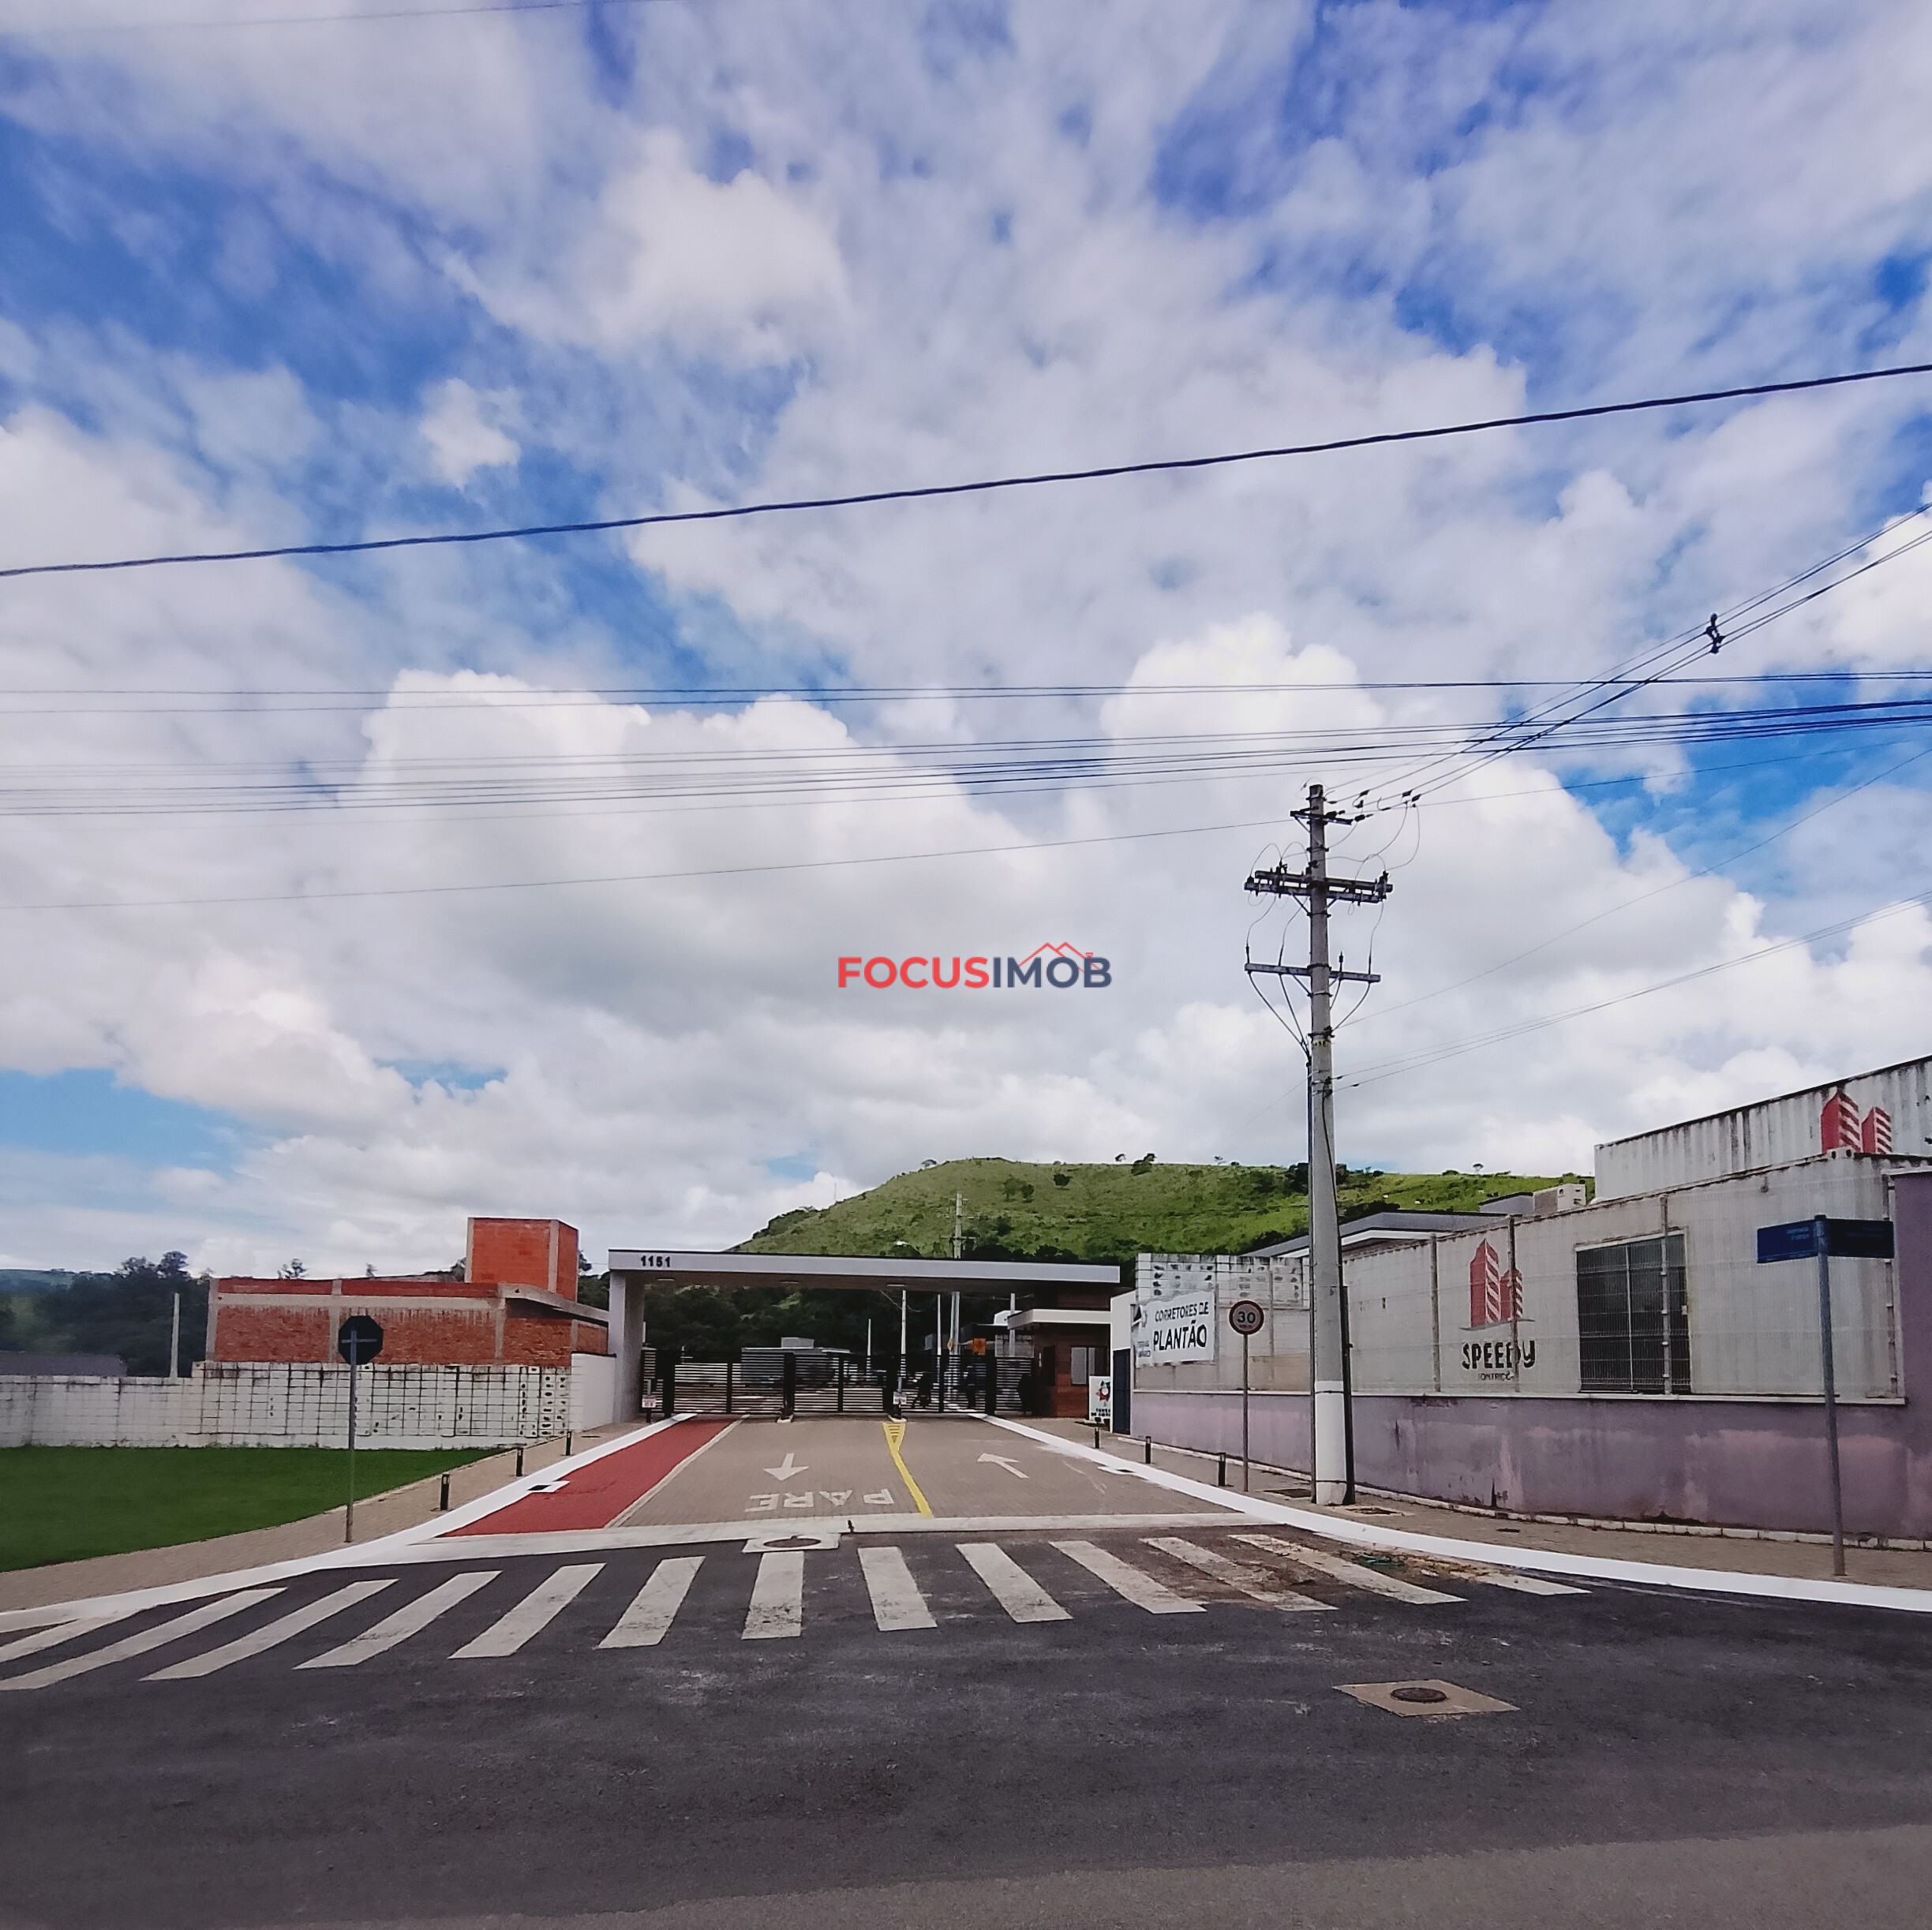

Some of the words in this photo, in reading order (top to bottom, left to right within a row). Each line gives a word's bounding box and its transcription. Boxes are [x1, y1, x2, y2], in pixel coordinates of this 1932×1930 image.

[640, 1255, 671, 1268] 1151
[1155, 1303, 1197, 1322] CORRETORES
[1198, 1301, 1209, 1315] DE
[1237, 1311, 1256, 1324] 30
[1153, 1319, 1208, 1352] PLANTÃO
[1462, 1340, 1536, 1370] SPEEDY
[744, 1488, 894, 1513] PARE
